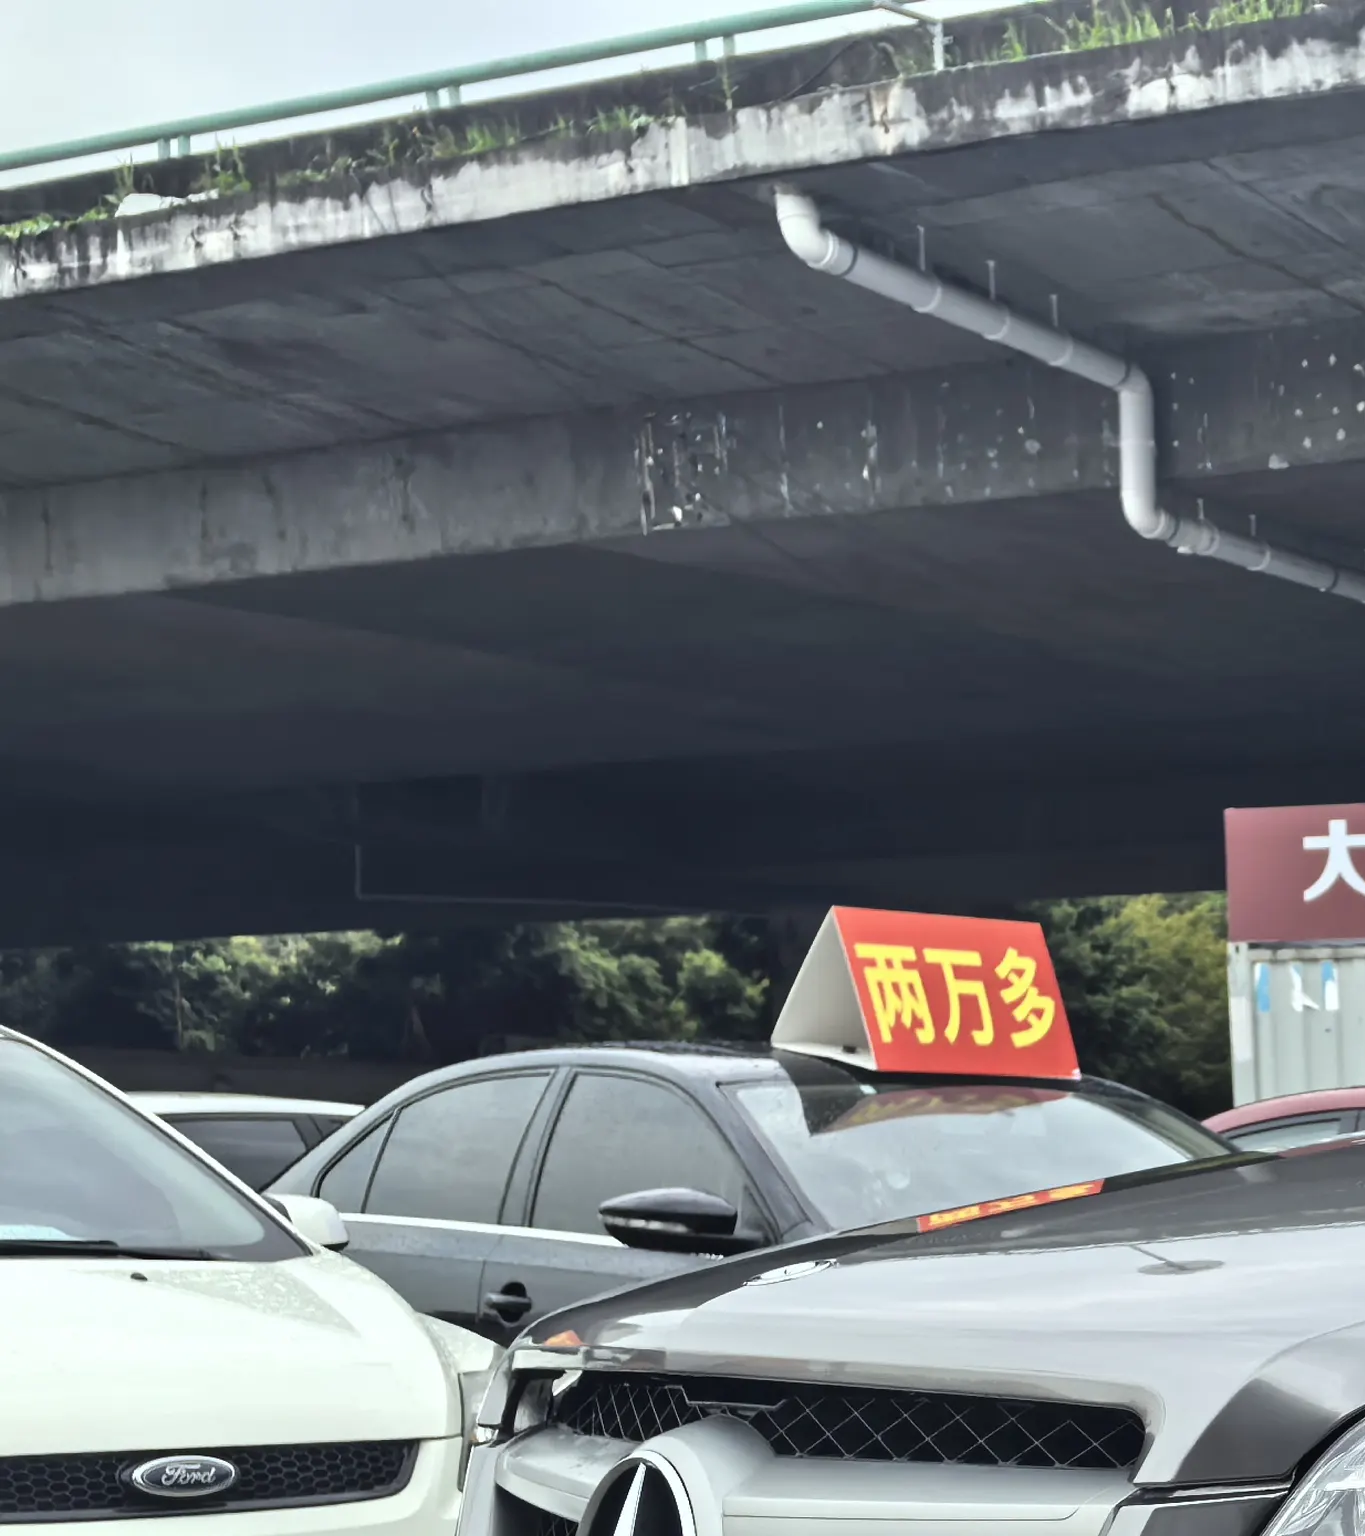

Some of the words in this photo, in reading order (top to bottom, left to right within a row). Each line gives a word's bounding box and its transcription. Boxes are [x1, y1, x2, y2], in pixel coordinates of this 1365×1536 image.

[853, 942, 1056, 1048] 两万多
[161, 1463, 217, 1486] Ford
